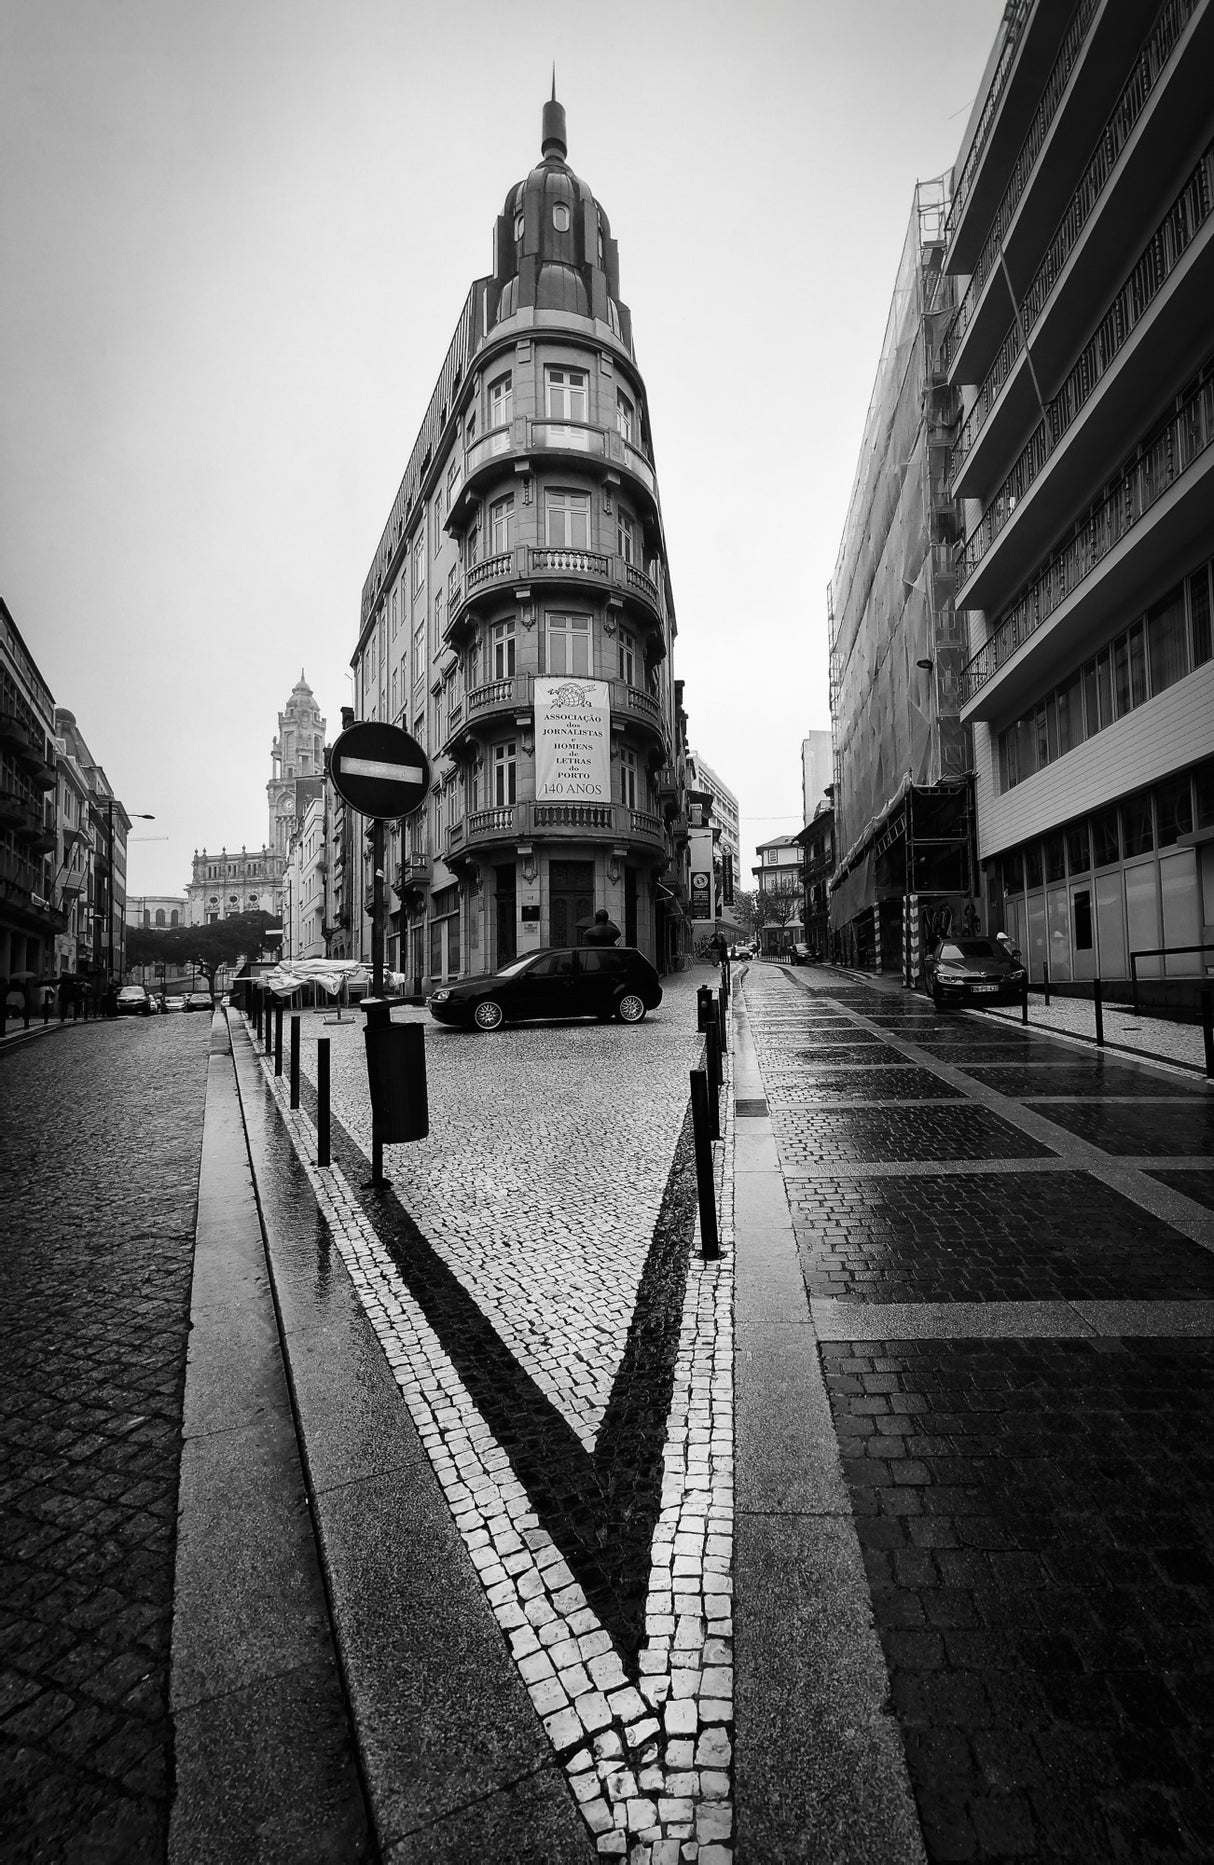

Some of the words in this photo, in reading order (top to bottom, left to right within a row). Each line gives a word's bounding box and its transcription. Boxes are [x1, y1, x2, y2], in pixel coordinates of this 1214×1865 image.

[544, 714, 601, 722] ASSOCIAÇÃO
[542, 729, 603, 737] JORNALISTAS
[544, 783, 563, 794] 140
[566, 784, 602, 795] ANOS
